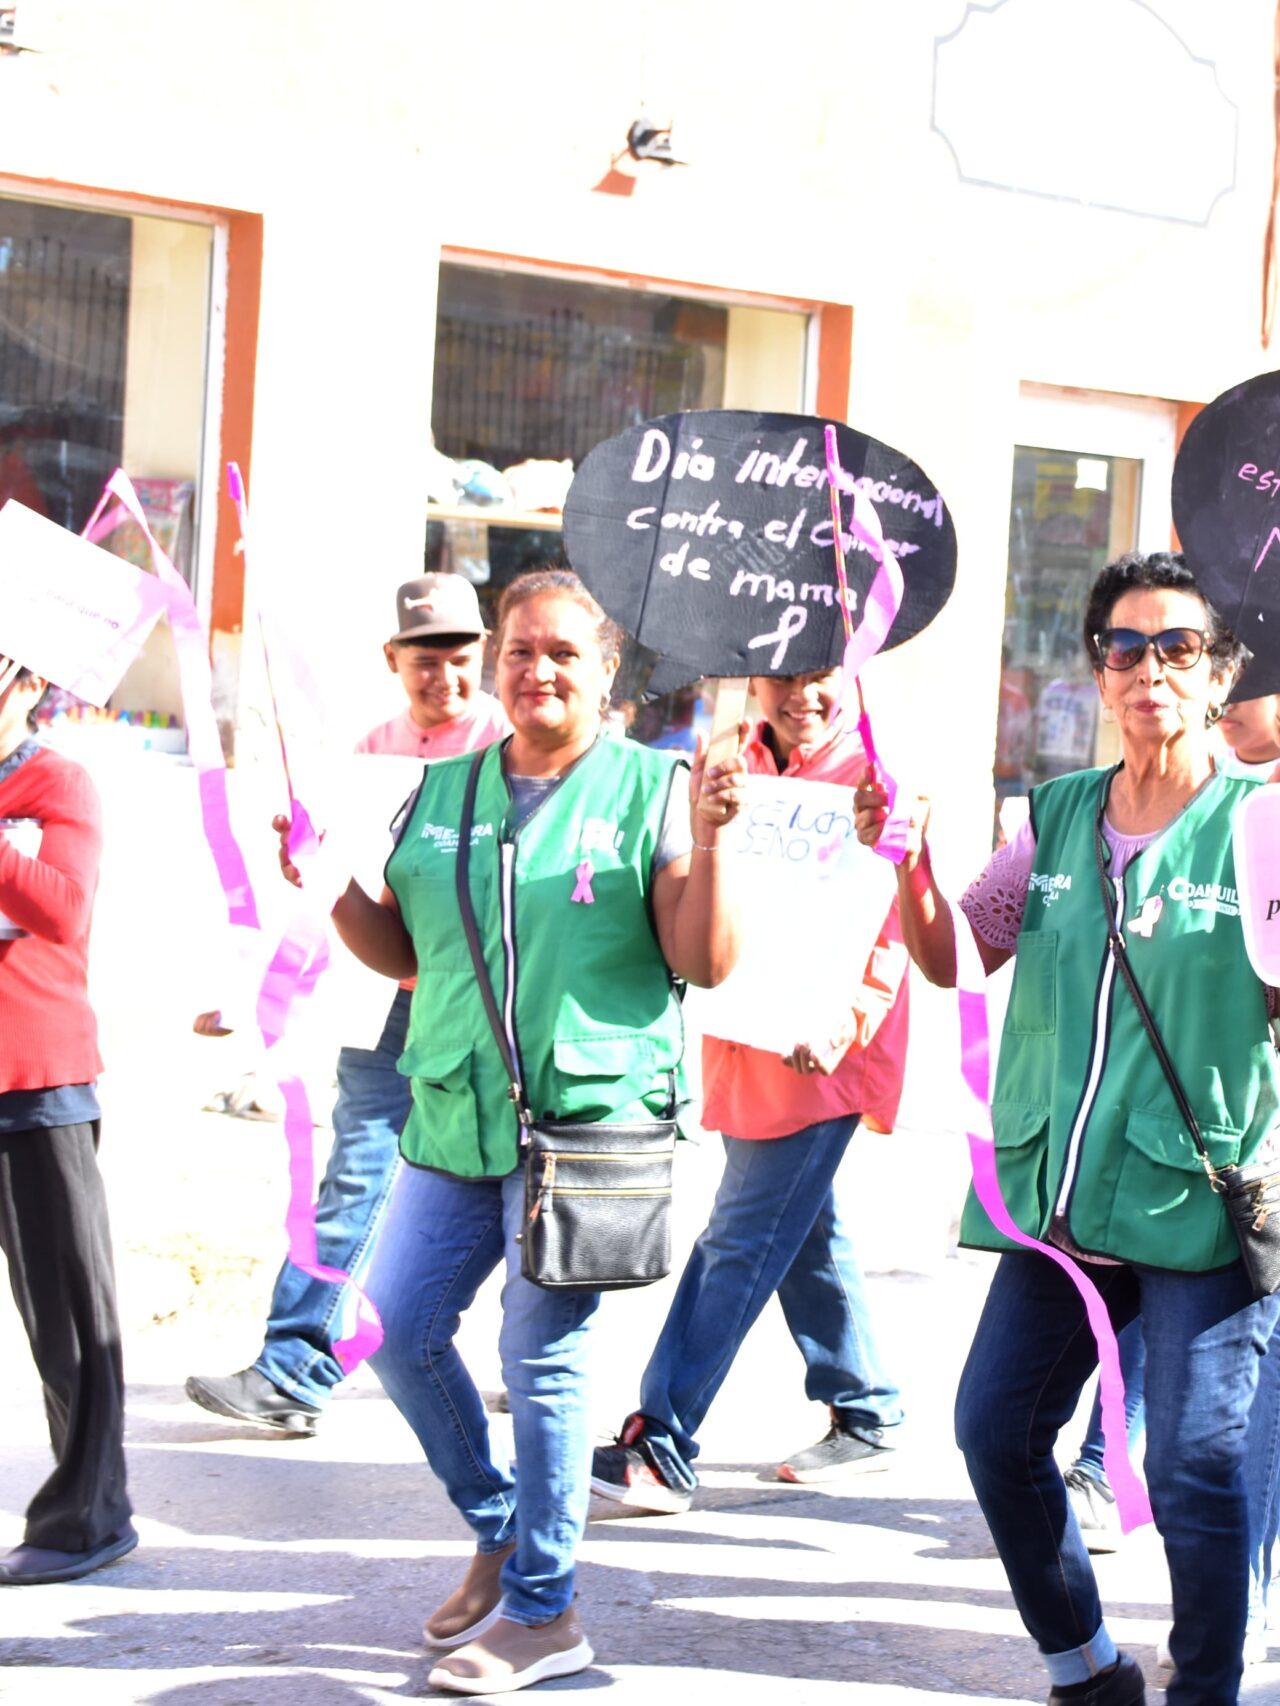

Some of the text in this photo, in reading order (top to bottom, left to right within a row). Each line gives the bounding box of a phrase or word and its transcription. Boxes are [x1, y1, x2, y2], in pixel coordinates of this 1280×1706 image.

[764, 508, 808, 549] el
[659, 540, 858, 612] de mama
